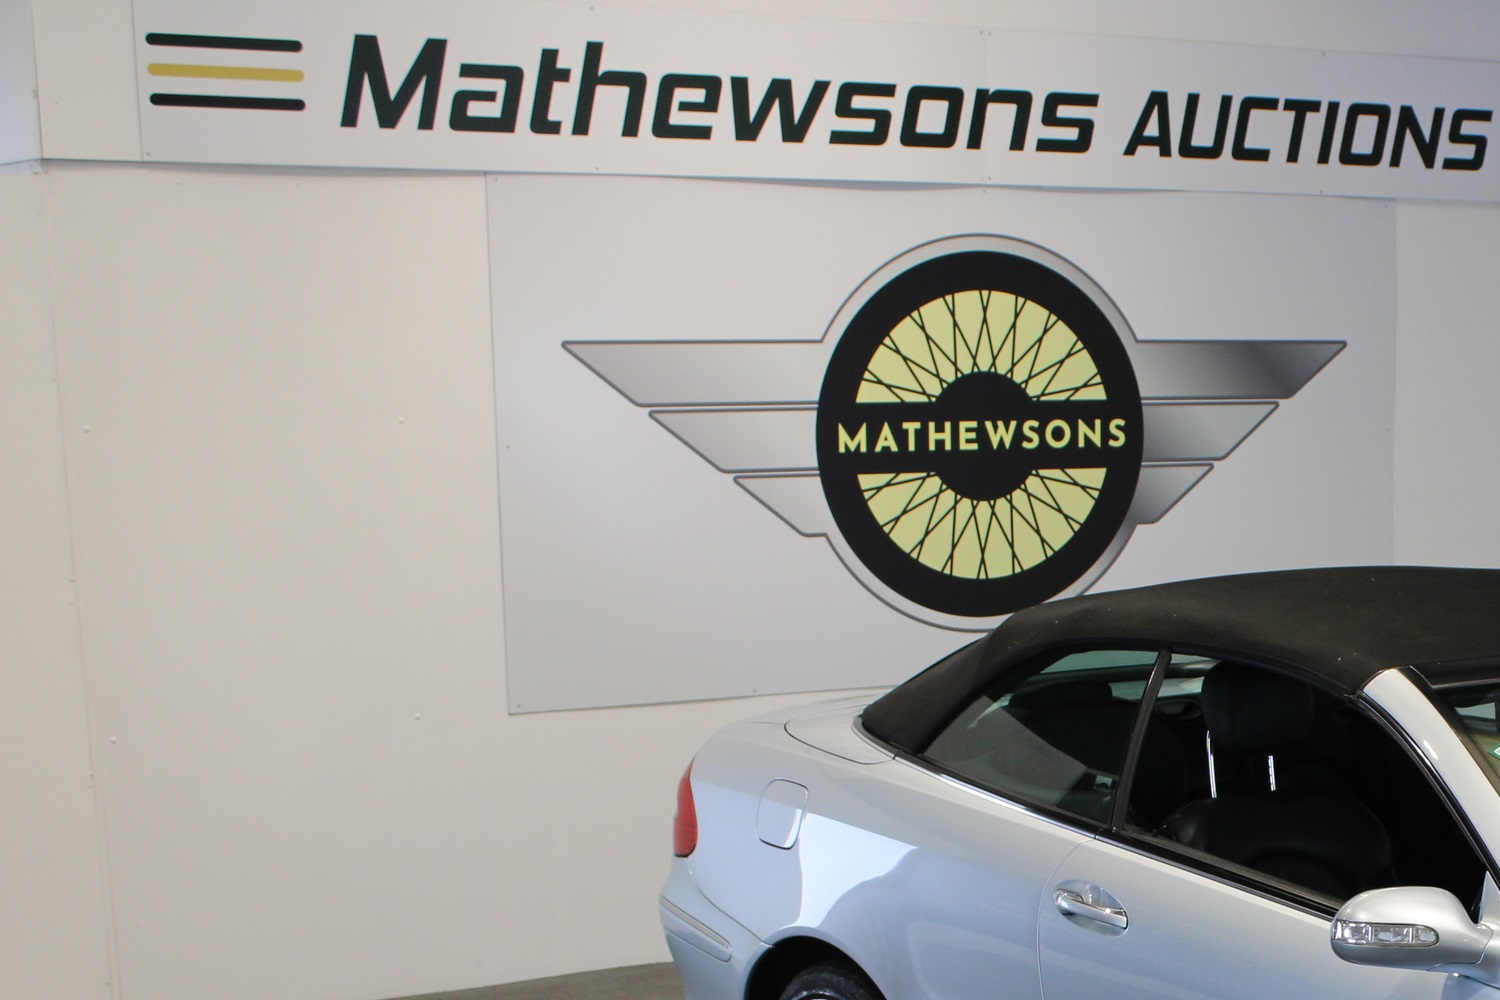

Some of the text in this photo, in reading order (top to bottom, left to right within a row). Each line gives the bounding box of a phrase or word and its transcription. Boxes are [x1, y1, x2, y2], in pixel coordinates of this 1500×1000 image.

[340, 33, 1494, 171] Mathewsons AUCTIONS
[837, 418, 1127, 454] MATHEWSONS
